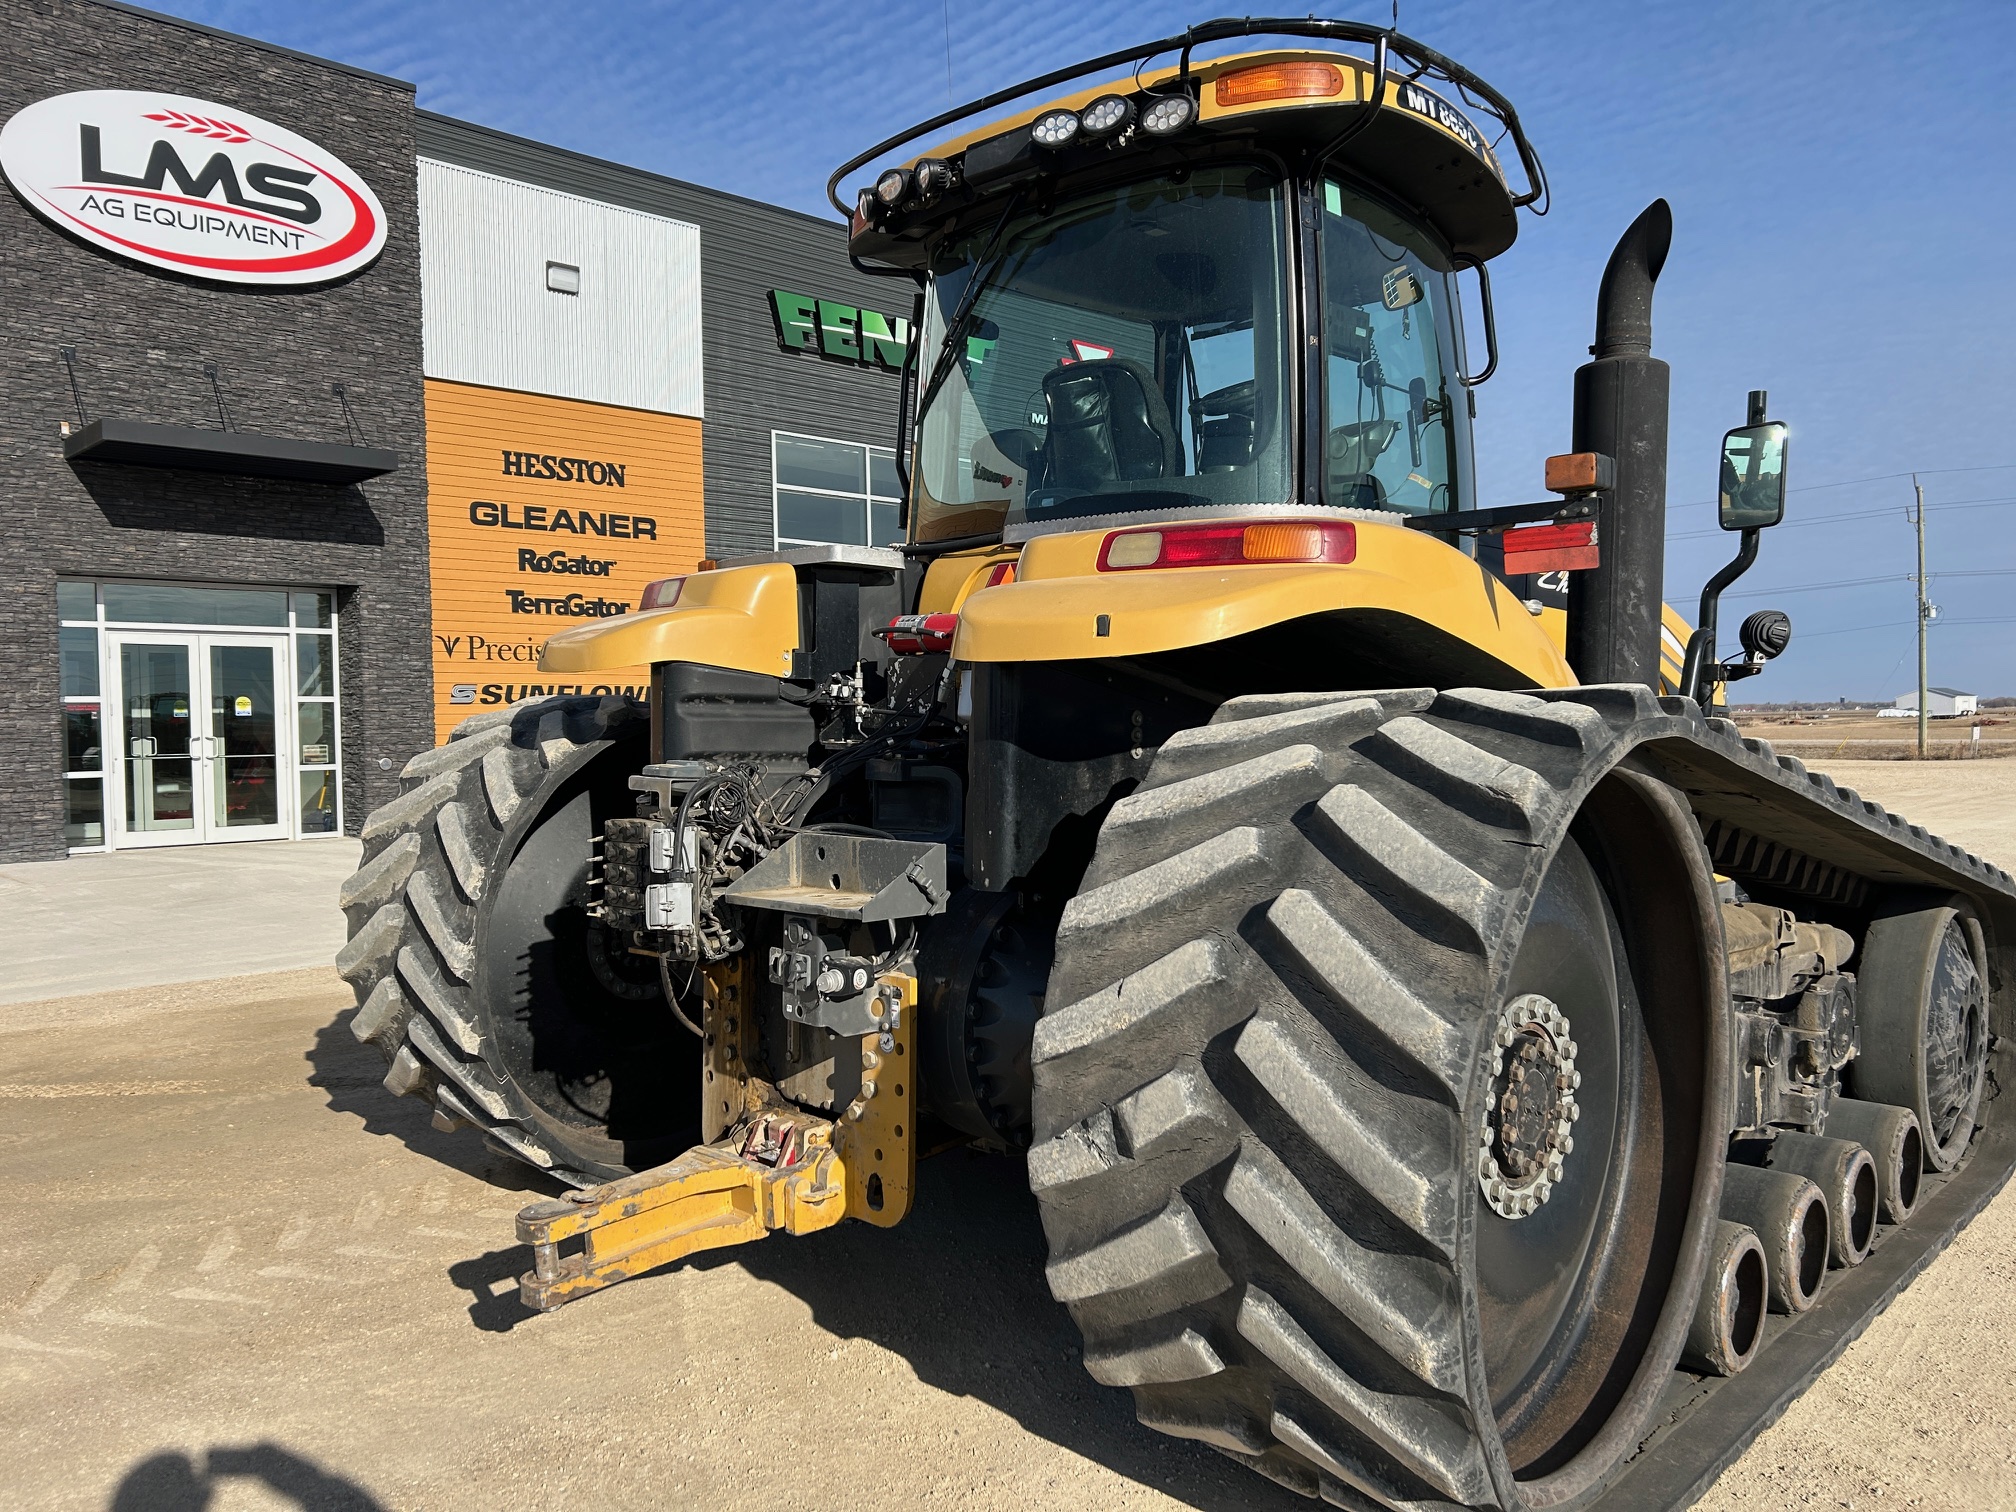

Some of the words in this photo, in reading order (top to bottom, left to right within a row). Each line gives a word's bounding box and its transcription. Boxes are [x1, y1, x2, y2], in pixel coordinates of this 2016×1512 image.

[1405, 84, 1436, 119] MT
[80, 122, 322, 225] LMS
[79, 194, 125, 218] AG
[134, 206, 305, 251] EQUIPMENT
[501, 450, 626, 488] HESSTON
[469, 501, 657, 541] GLEANER
[518, 548, 616, 576] RoGator
[505, 589, 630, 618] TerraGator
